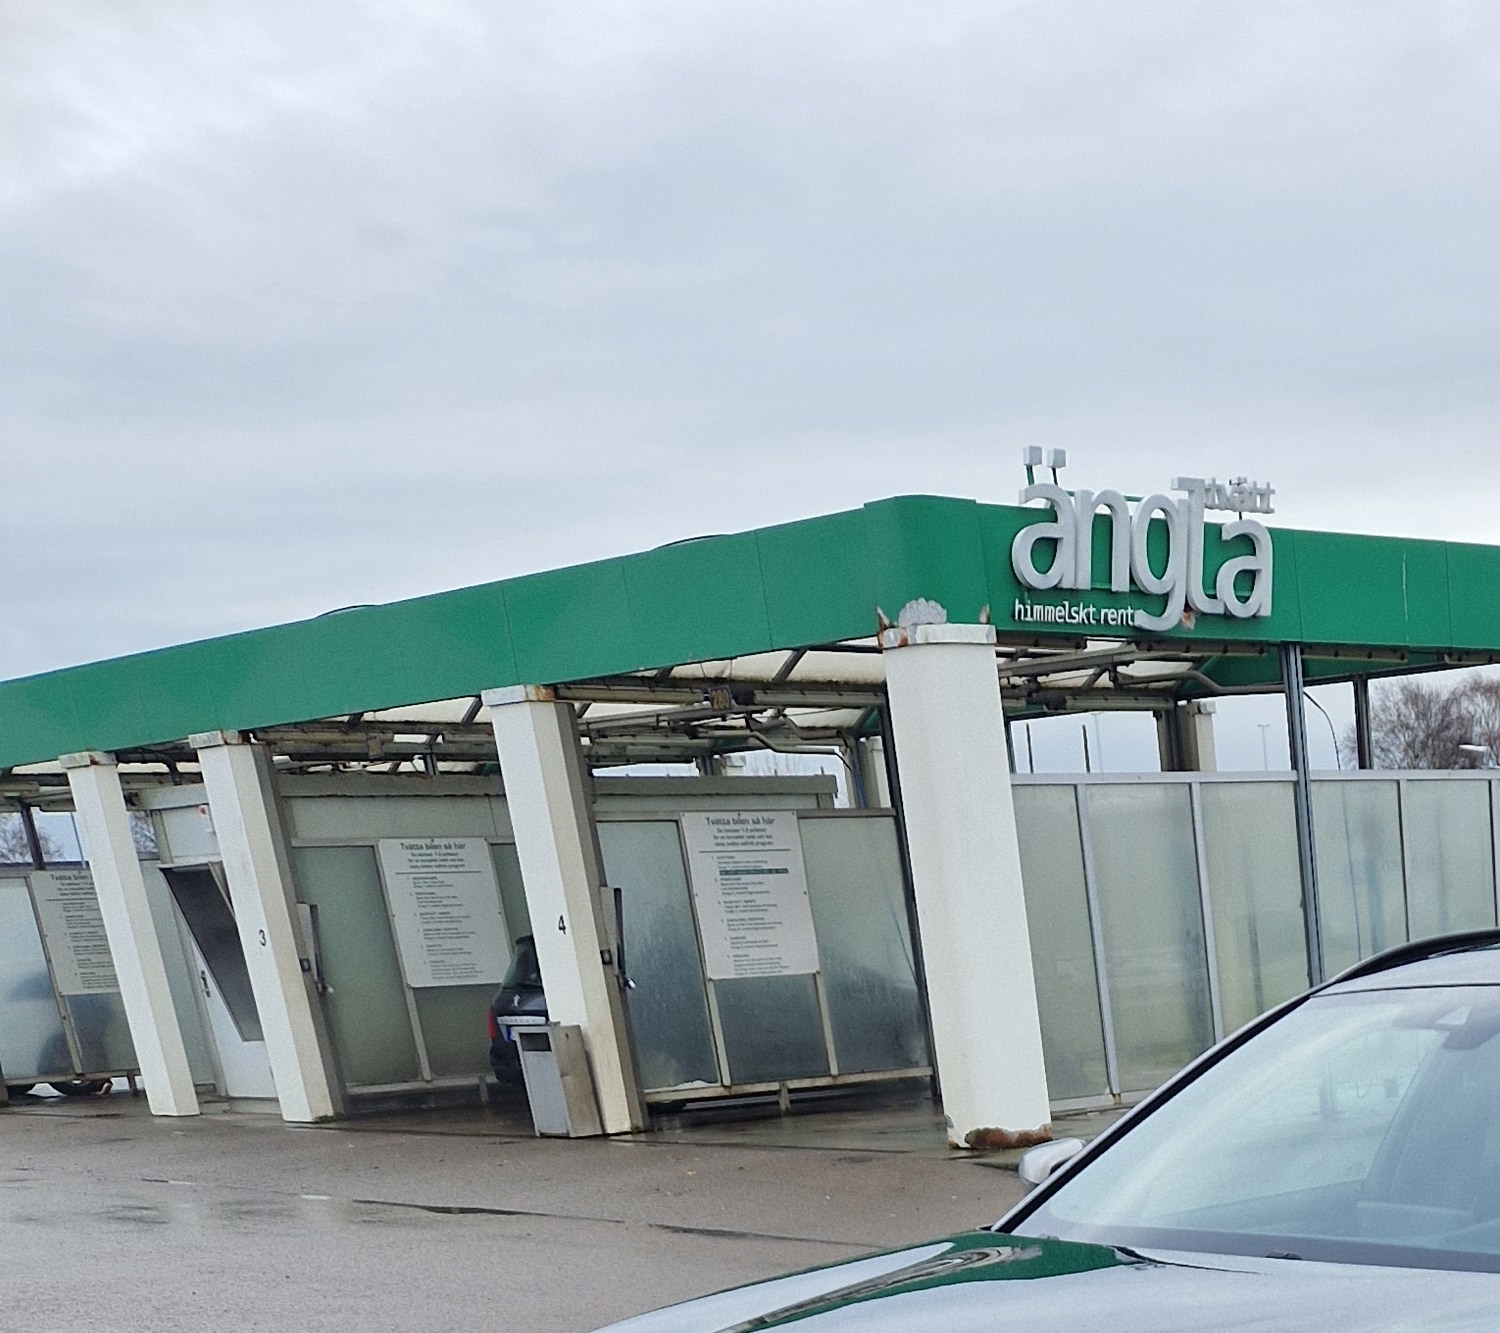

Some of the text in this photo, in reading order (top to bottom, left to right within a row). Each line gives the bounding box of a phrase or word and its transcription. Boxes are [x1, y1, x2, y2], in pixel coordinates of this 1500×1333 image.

[1014, 598, 1135, 627] himmelskt rent
[558, 914, 567, 935] 4
[258, 928, 267, 947] 3
